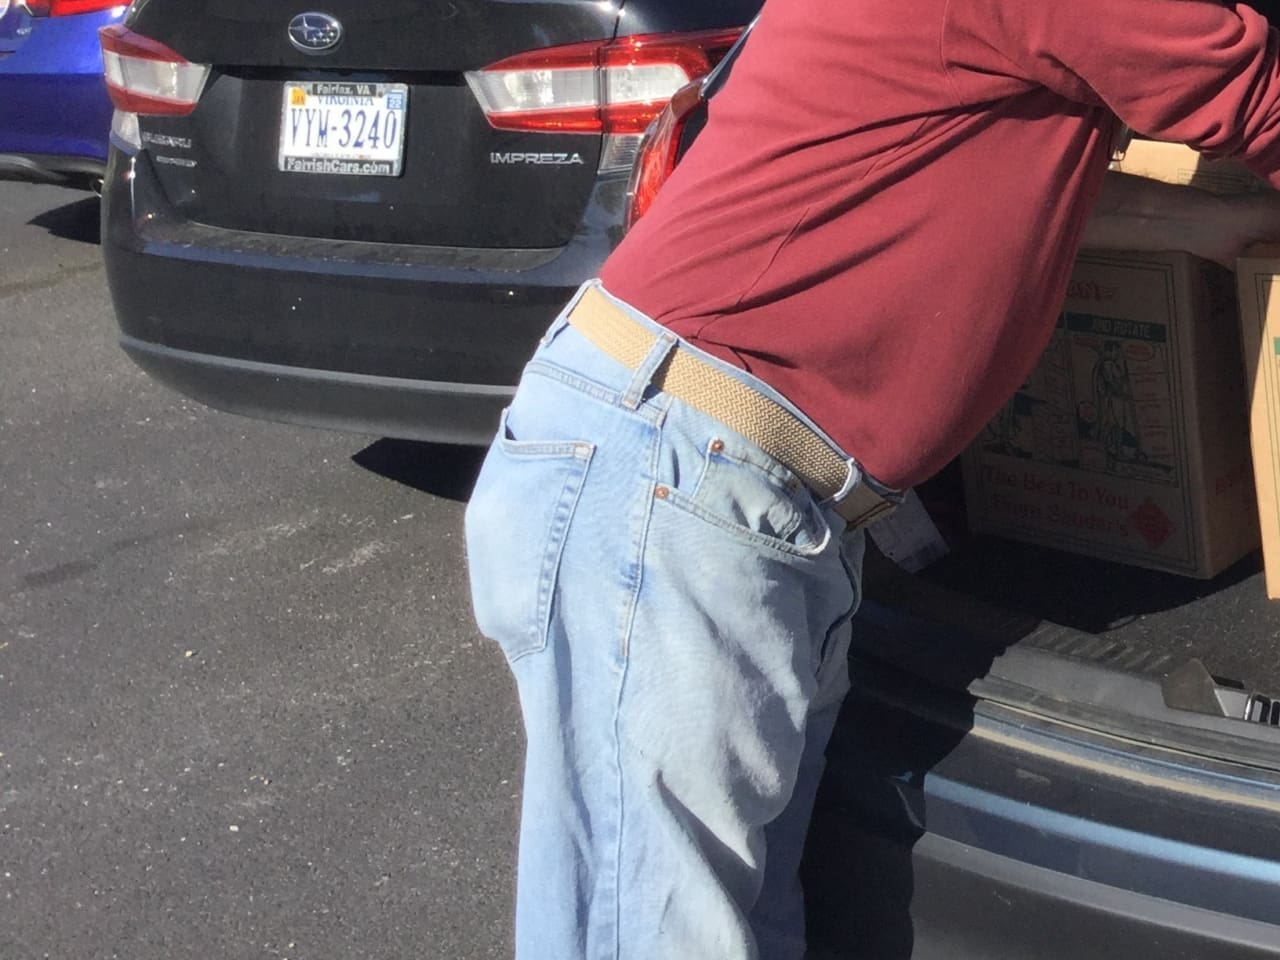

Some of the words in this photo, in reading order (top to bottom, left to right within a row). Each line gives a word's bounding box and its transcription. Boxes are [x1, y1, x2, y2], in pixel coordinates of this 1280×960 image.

[357, 84, 371, 96] VA
[317, 95, 375, 107] VIRGINIA
[291, 108, 398, 149] VYM-3240
[489, 151, 585, 165] IMPREZA
[1095, 487, 1129, 510] You
